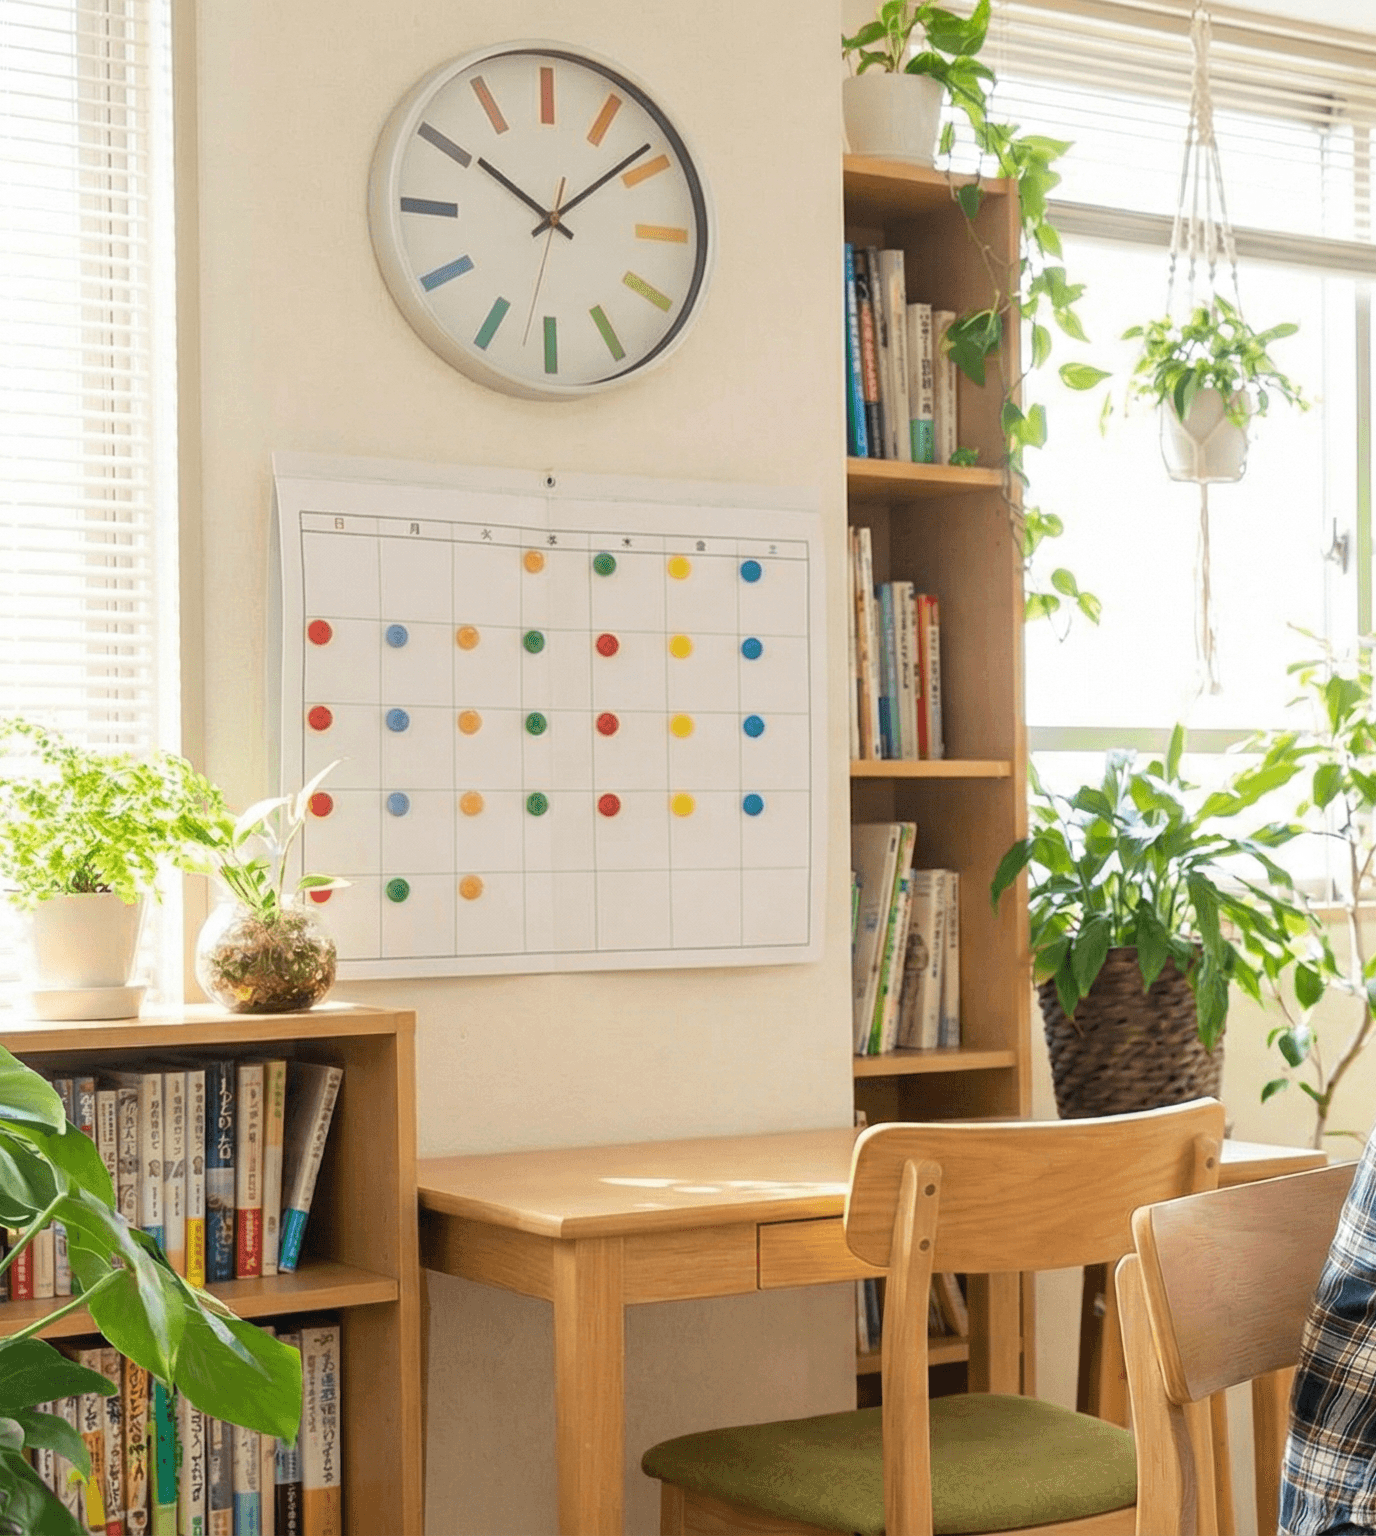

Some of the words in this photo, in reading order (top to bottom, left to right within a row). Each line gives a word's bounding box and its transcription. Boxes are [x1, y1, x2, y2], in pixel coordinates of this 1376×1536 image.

[335, 518, 344, 529] 日
[410, 523, 420, 535] 月
[481, 529, 492, 541] 火
[621, 536, 632, 547] 木
